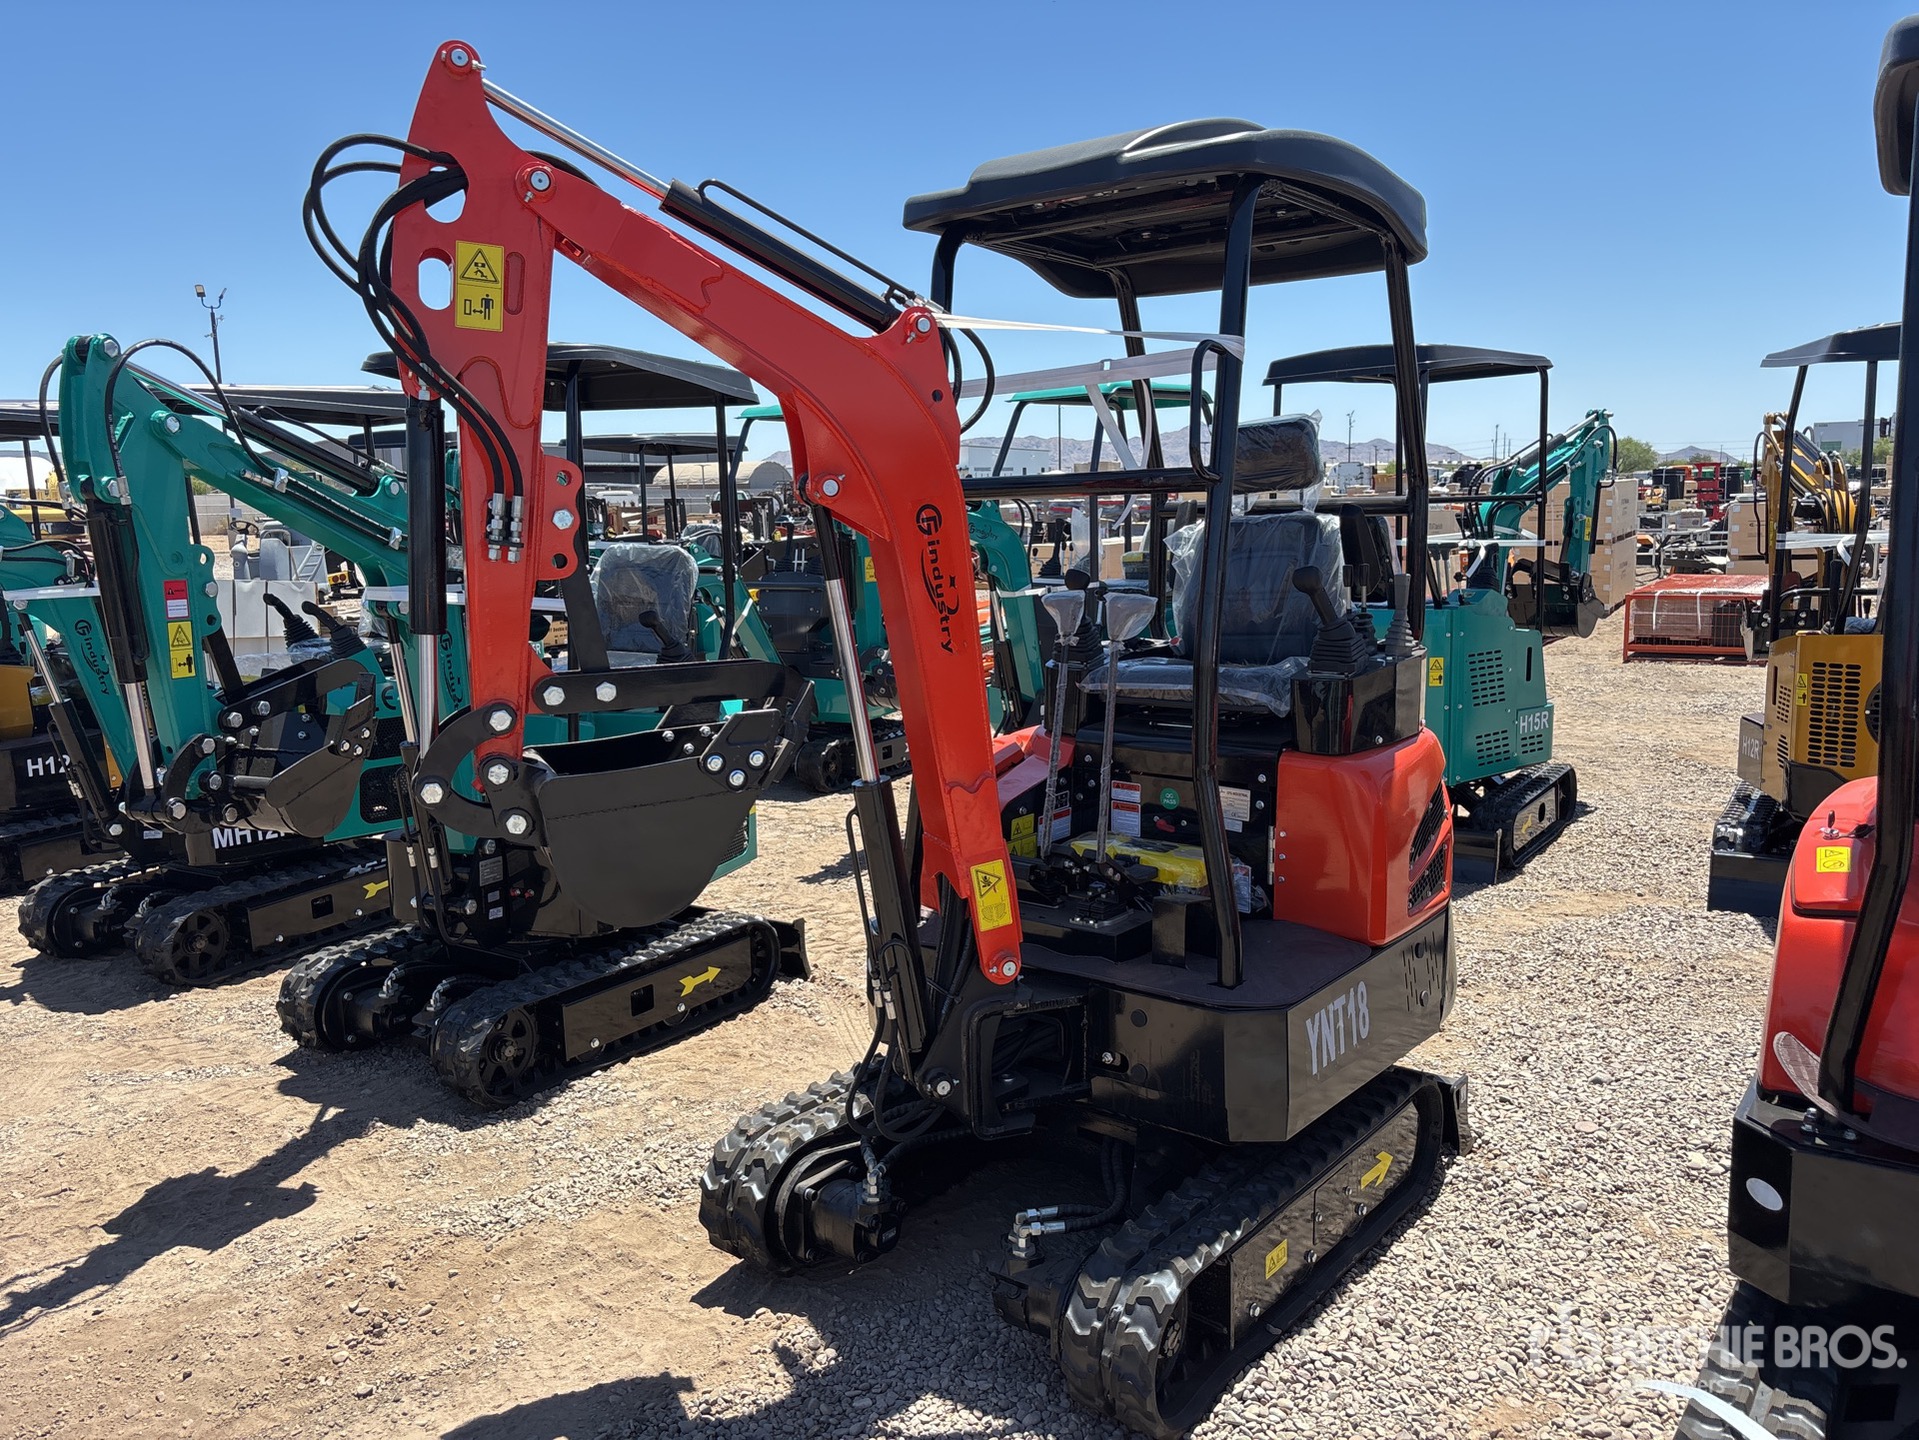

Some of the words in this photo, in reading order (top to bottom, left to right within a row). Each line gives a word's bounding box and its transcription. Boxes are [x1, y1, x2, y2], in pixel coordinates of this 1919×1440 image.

[1519, 711, 1550, 735] H15R
[1741, 734, 1761, 760] H12R
[212, 826, 286, 850] MH12
[1305, 980, 1370, 1076] YNT18
